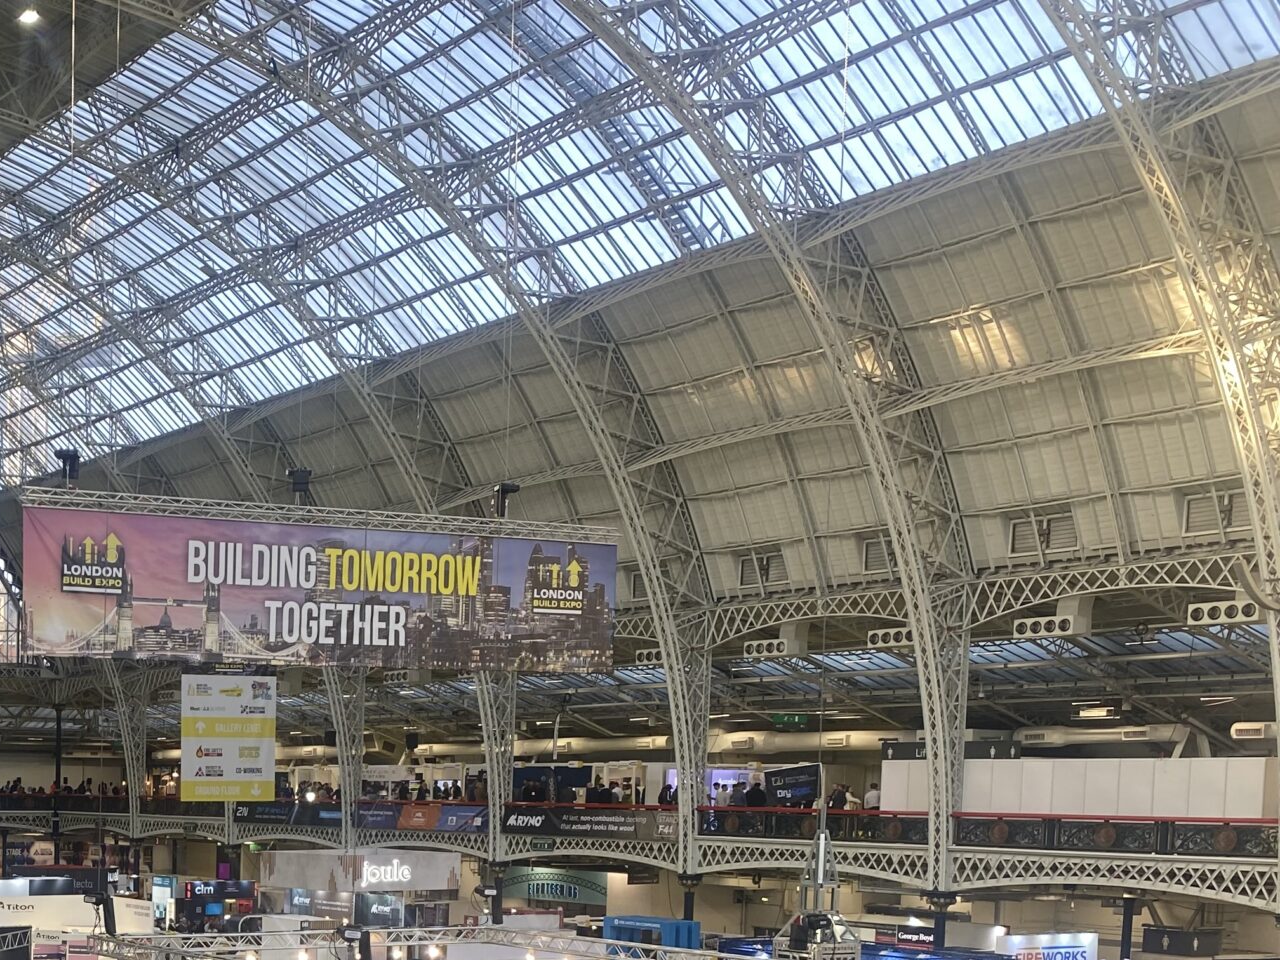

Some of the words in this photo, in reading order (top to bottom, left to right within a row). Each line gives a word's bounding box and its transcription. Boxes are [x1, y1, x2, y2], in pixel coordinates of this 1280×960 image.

[63, 564, 123, 578] LONDON
[187, 539, 317, 589] BUILDING
[326, 547, 481, 597] TOMORROW
[63, 576, 93, 586] BUILD
[95, 578, 122, 587] EXPO
[533, 589, 583, 601] LONDON
[533, 599, 557, 608] BUILD
[559, 601, 583, 610] EXPO
[265, 600, 406, 647] TOGETHER
[580, 815, 625, 823] non-combustible
[361, 859, 412, 888] joule
[195, 884, 214, 895] clm
[898, 931, 920, 943] George
[919, 932, 934, 943] Boyd
